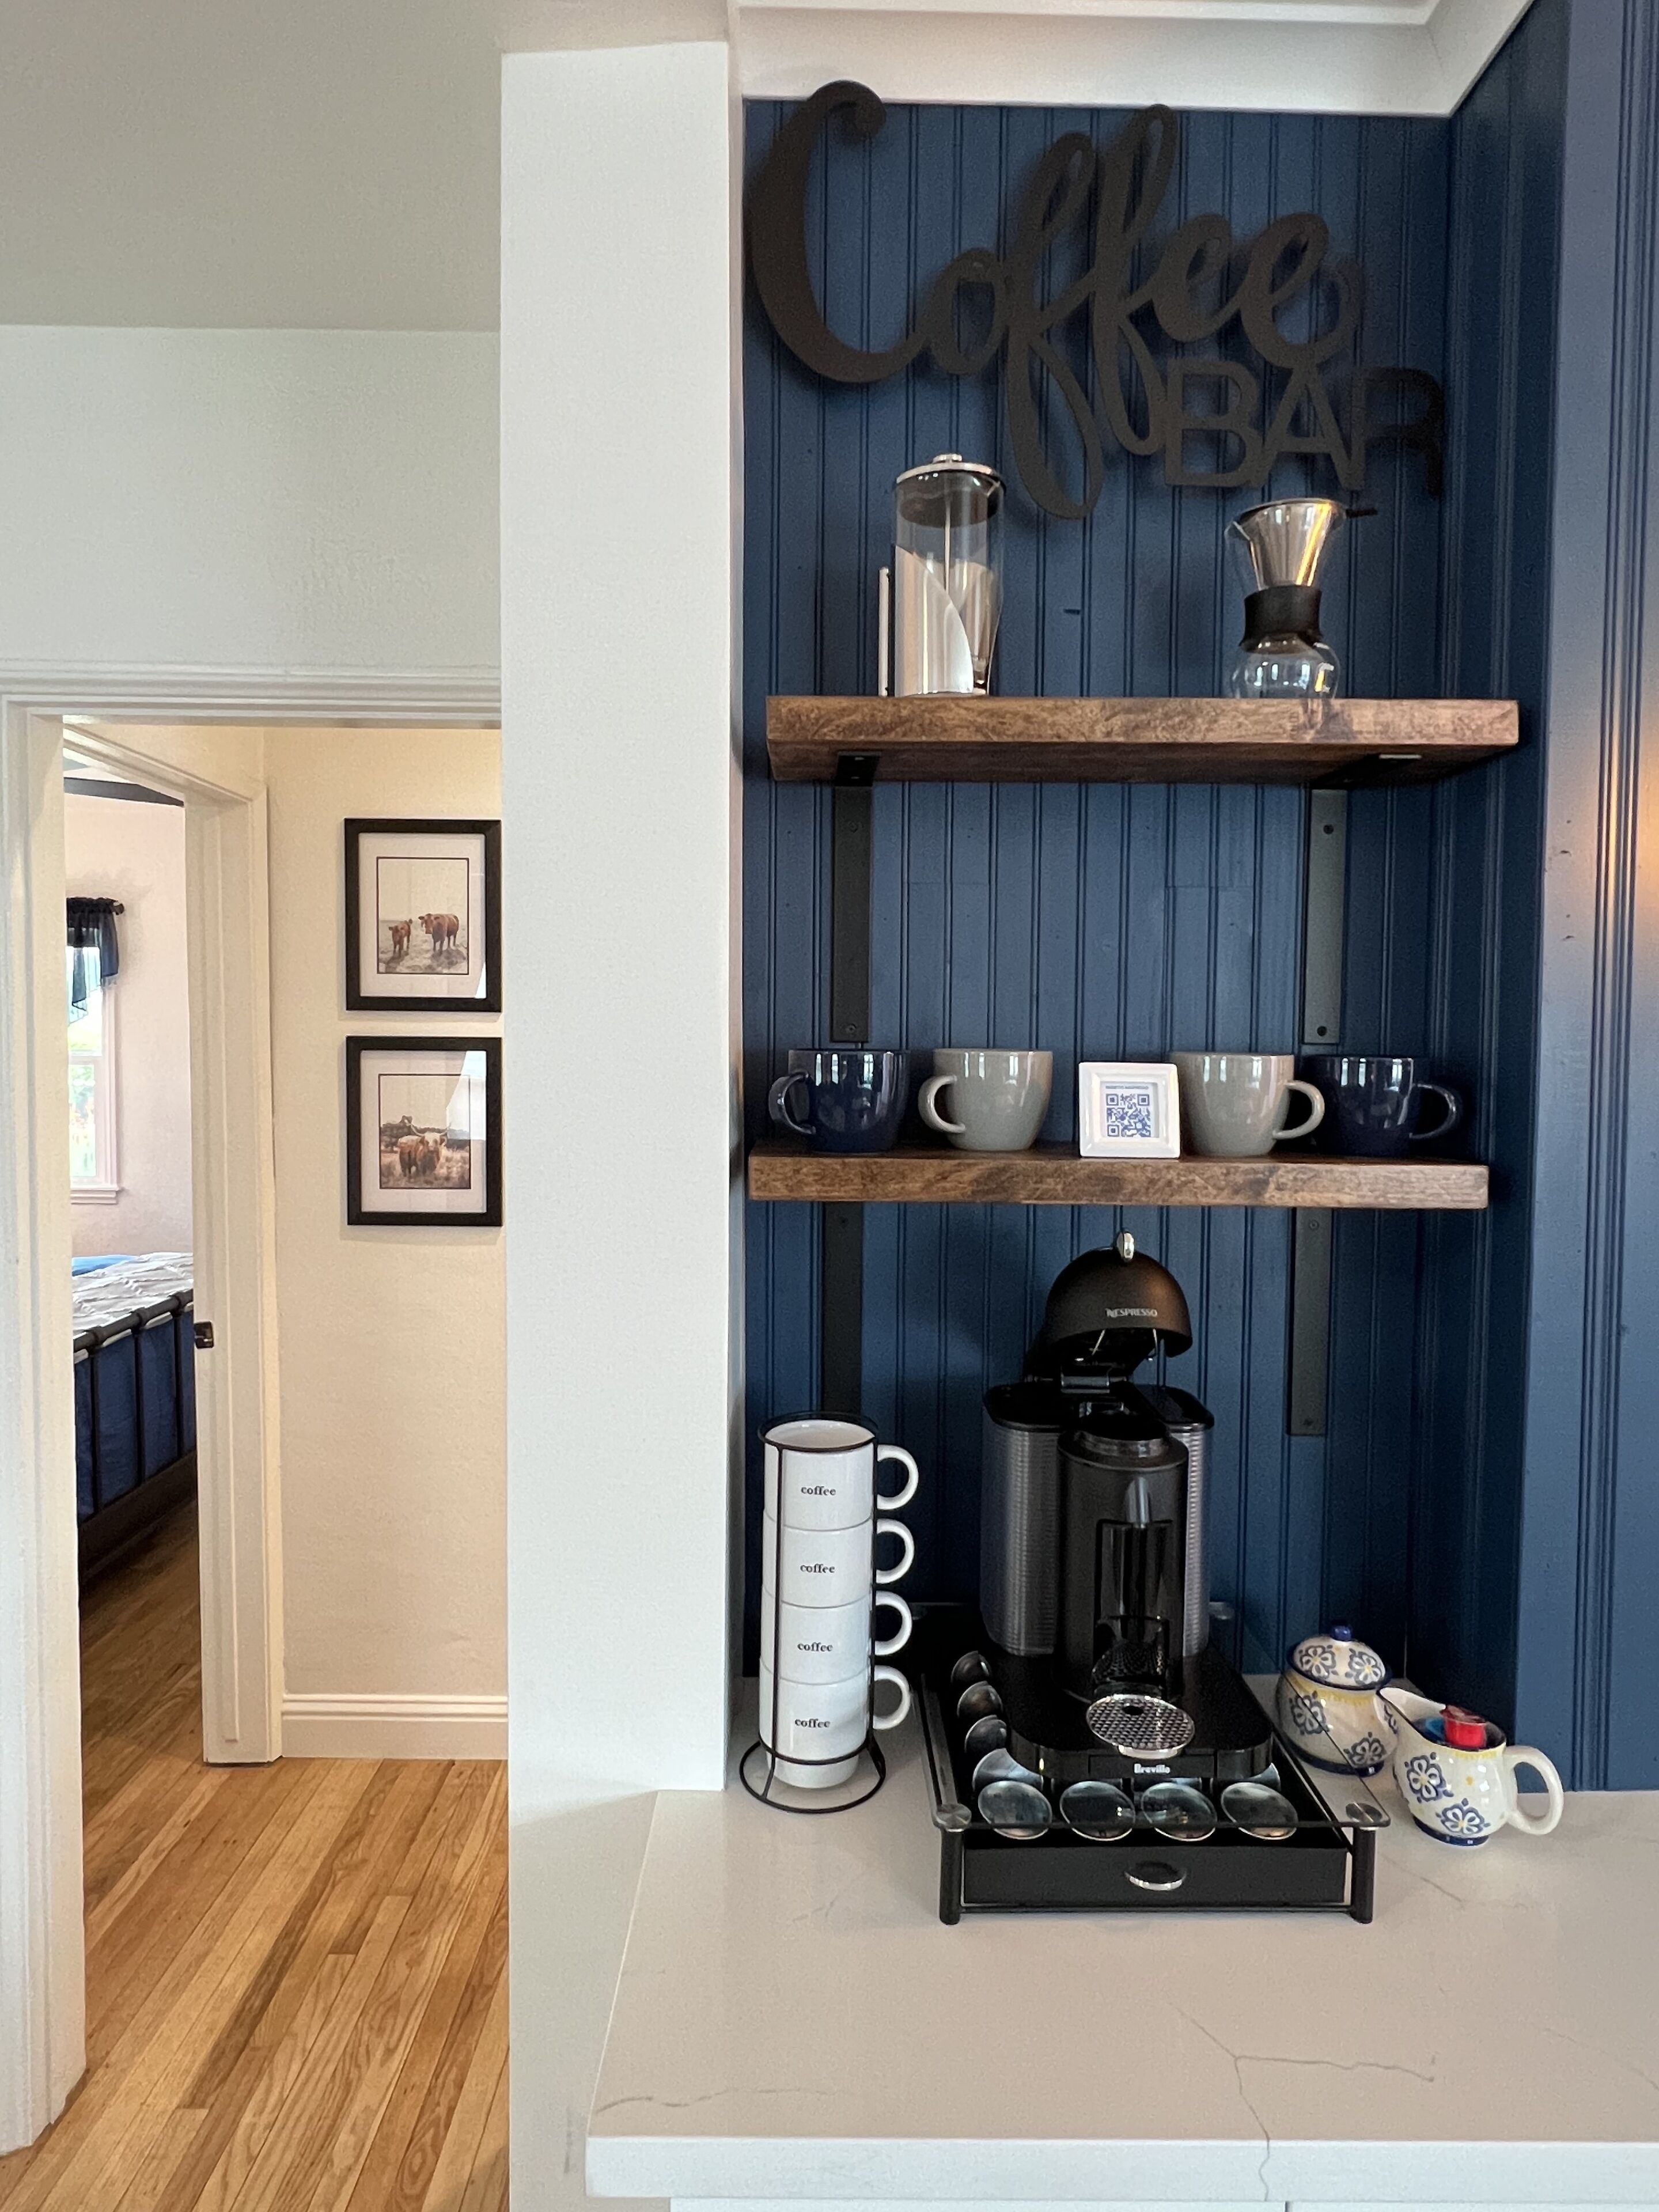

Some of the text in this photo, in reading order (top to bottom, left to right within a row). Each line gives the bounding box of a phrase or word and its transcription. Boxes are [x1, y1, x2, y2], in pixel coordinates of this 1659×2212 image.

[746, 81, 1361, 518] Coffee
[1165, 358, 1444, 497] BAR
[801, 1486, 836, 1495] coffee
[800, 1563, 835, 1573] coffee
[797, 1642, 833, 1652] coffee
[794, 1718, 830, 1728] coffee
